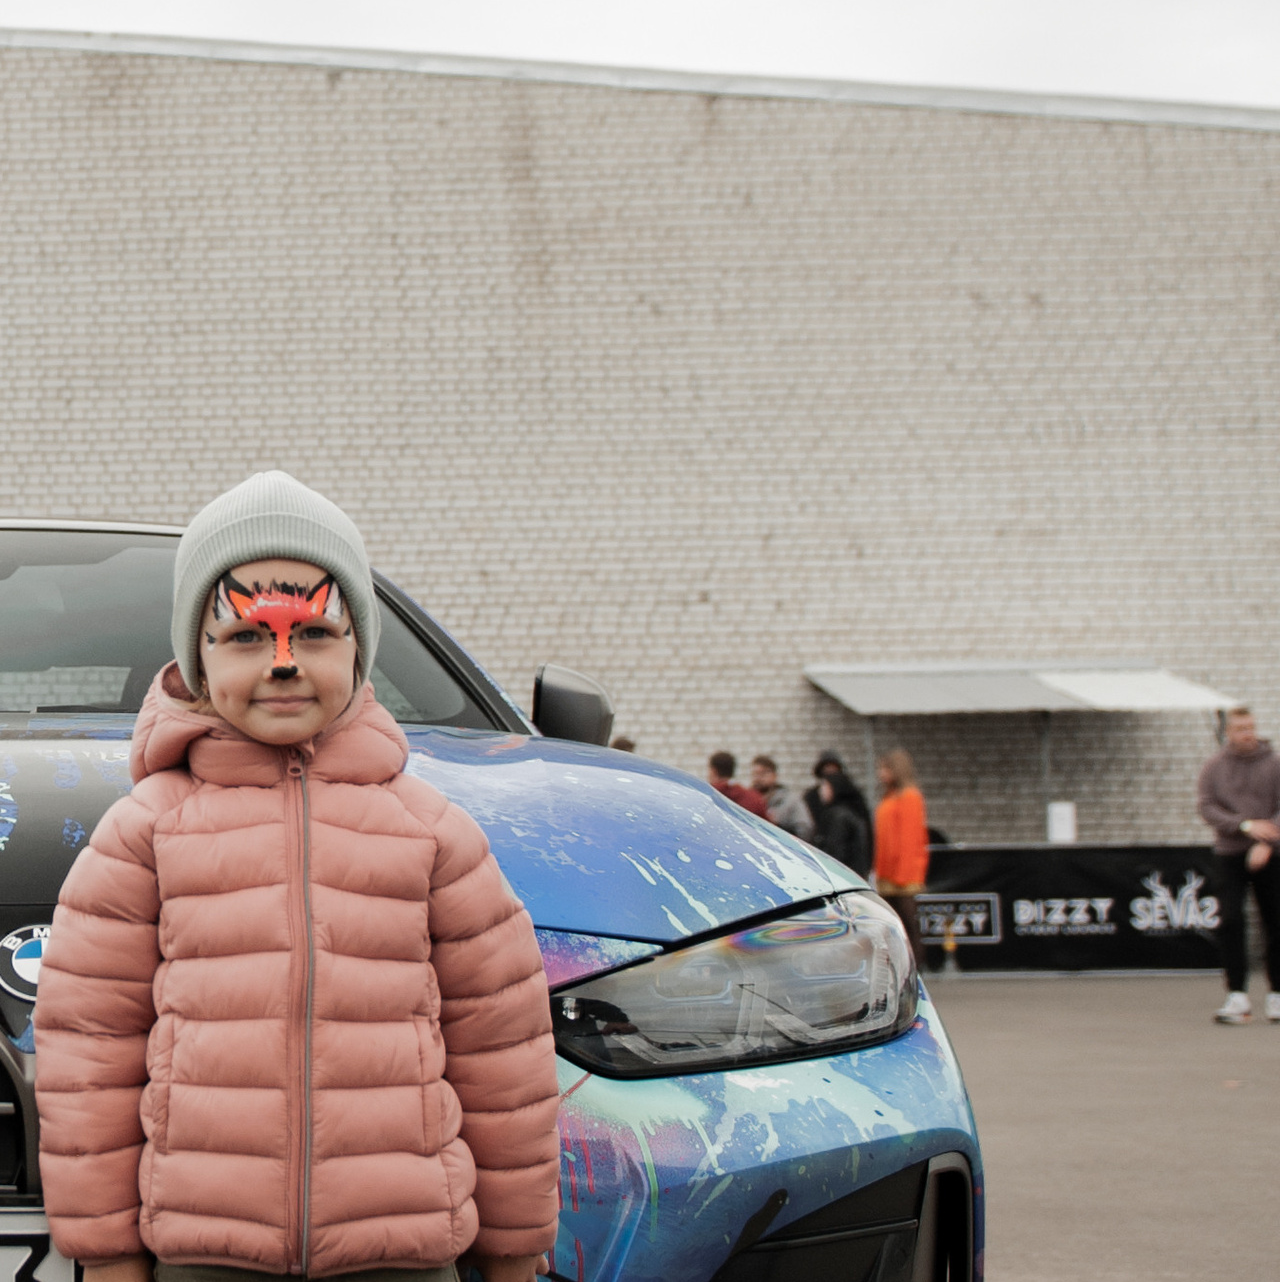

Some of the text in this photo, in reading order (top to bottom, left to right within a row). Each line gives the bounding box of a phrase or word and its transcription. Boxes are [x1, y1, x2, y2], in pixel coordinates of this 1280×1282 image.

[1013, 898, 1114, 925] DIZZY
[919, 913, 989, 935] IZZY
[2, 927, 51, 951] BM
